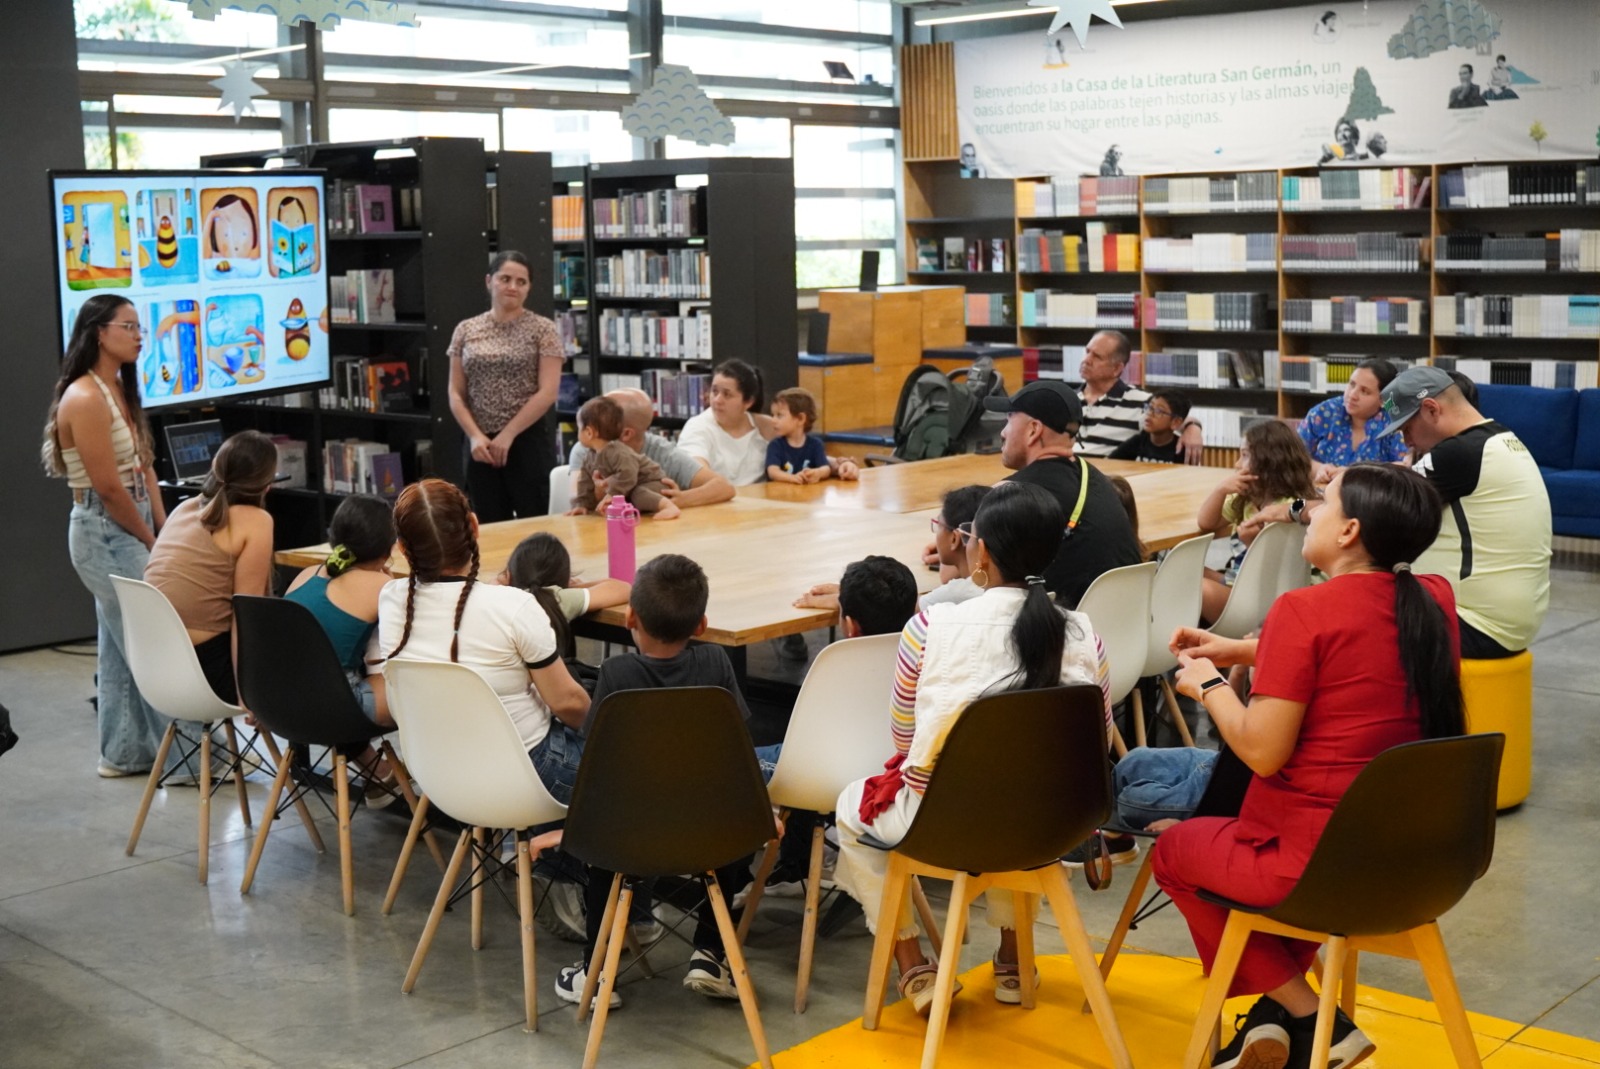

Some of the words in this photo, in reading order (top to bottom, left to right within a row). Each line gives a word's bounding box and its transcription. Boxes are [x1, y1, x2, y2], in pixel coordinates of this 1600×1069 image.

[973, 82, 1048, 99] Bienvenidos
[1051, 83, 1059, 94] a
[1061, 79, 1073, 93] la
[1076, 78, 1108, 92] Casa
[1111, 76, 1128, 90] de
[1131, 75, 1144, 89] la
[1147, 71, 1217, 88] Literatura
[1221, 68, 1248, 83] San
[1252, 60, 1318, 80] Germán,
[1321, 61, 1341, 75] un
[973, 104, 1004, 117] oasis
[1006, 100, 1046, 116] donde
[1050, 98, 1067, 113] las
[1070, 94, 1127, 114] palabras
[1129, 92, 1163, 108] tejen
[1166, 89, 1226, 107] historias
[1228, 90, 1237, 106] y
[1241, 86, 1262, 102] las
[1265, 83, 1309, 100] almas
[975, 119, 1044, 135] encuentran
[1047, 119, 1061, 131] su
[1064, 115, 1101, 134] hogar
[1104, 113, 1140, 129] entre
[1143, 111, 1162, 127] las
[1165, 109, 1223, 128] páginas.
